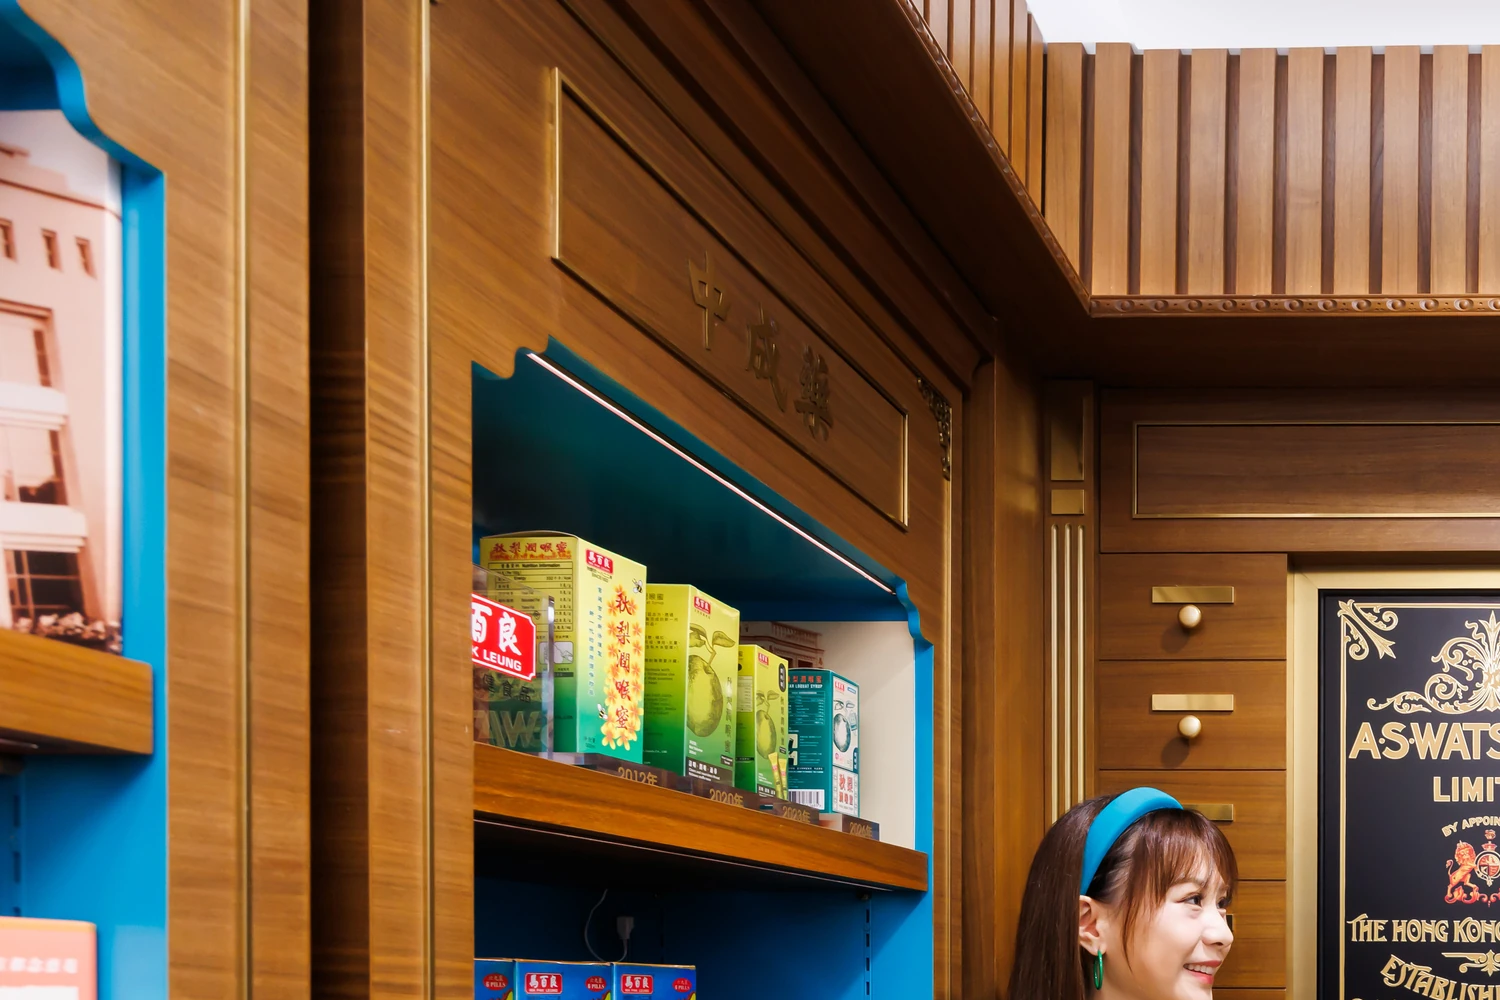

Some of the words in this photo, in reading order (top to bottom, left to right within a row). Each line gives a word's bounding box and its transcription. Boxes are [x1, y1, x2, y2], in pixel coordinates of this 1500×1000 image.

[483, 649, 522, 671] LEUNG
[615, 592, 632, 730] 秋梨潤喉蜜
[618, 766, 658, 786] 2012年
[709, 788, 744, 807] 2020年
[1442, 821, 1458, 837] BY
[1347, 913, 1387, 943] THE
[1391, 919, 1449, 943] HONG
[529, 975, 558, 989] 馬百良
[624, 976, 650, 989] 馬百良
